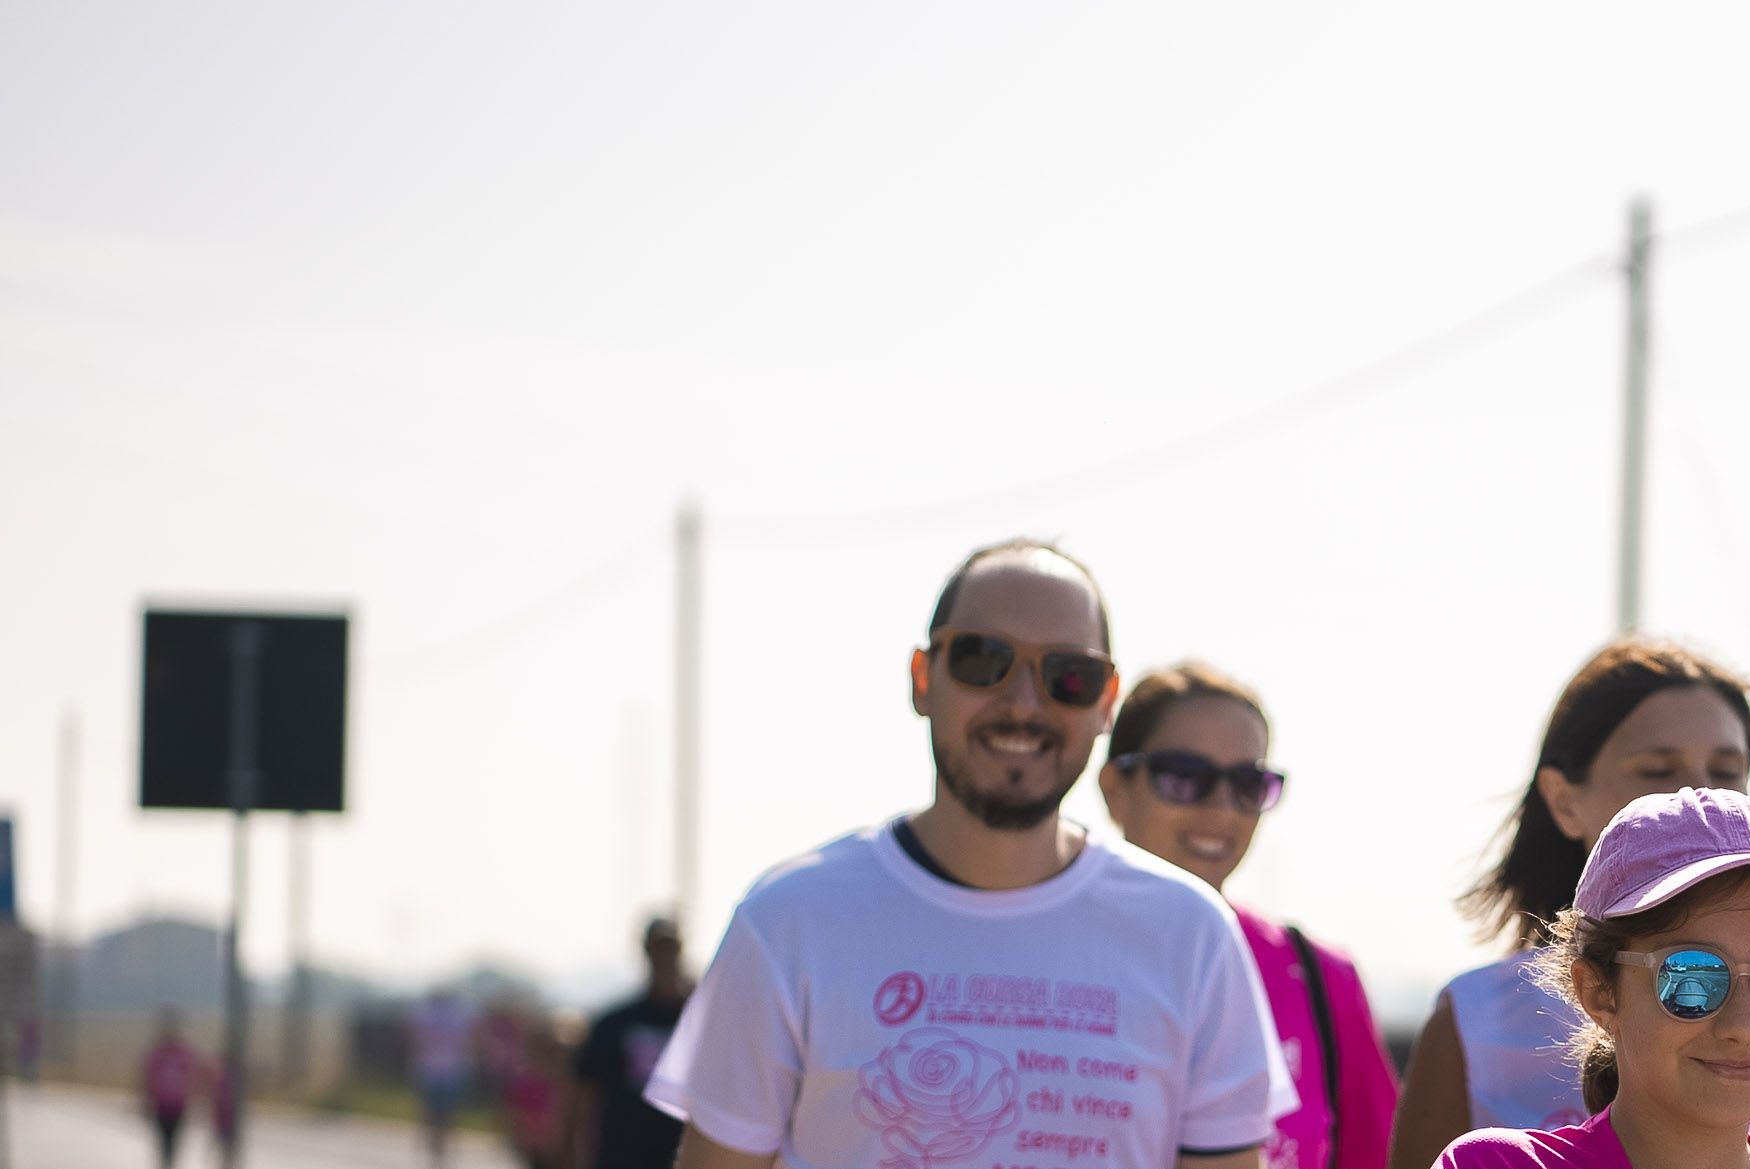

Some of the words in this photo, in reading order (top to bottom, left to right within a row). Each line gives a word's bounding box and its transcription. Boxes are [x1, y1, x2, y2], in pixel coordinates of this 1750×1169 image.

[1016, 1050, 1069, 1073] Non
[1077, 1055, 1138, 1082] come
[1027, 1088, 1064, 1113] chi
[1073, 1094, 1133, 1120] vince
[1015, 1130, 1109, 1160] sempre
